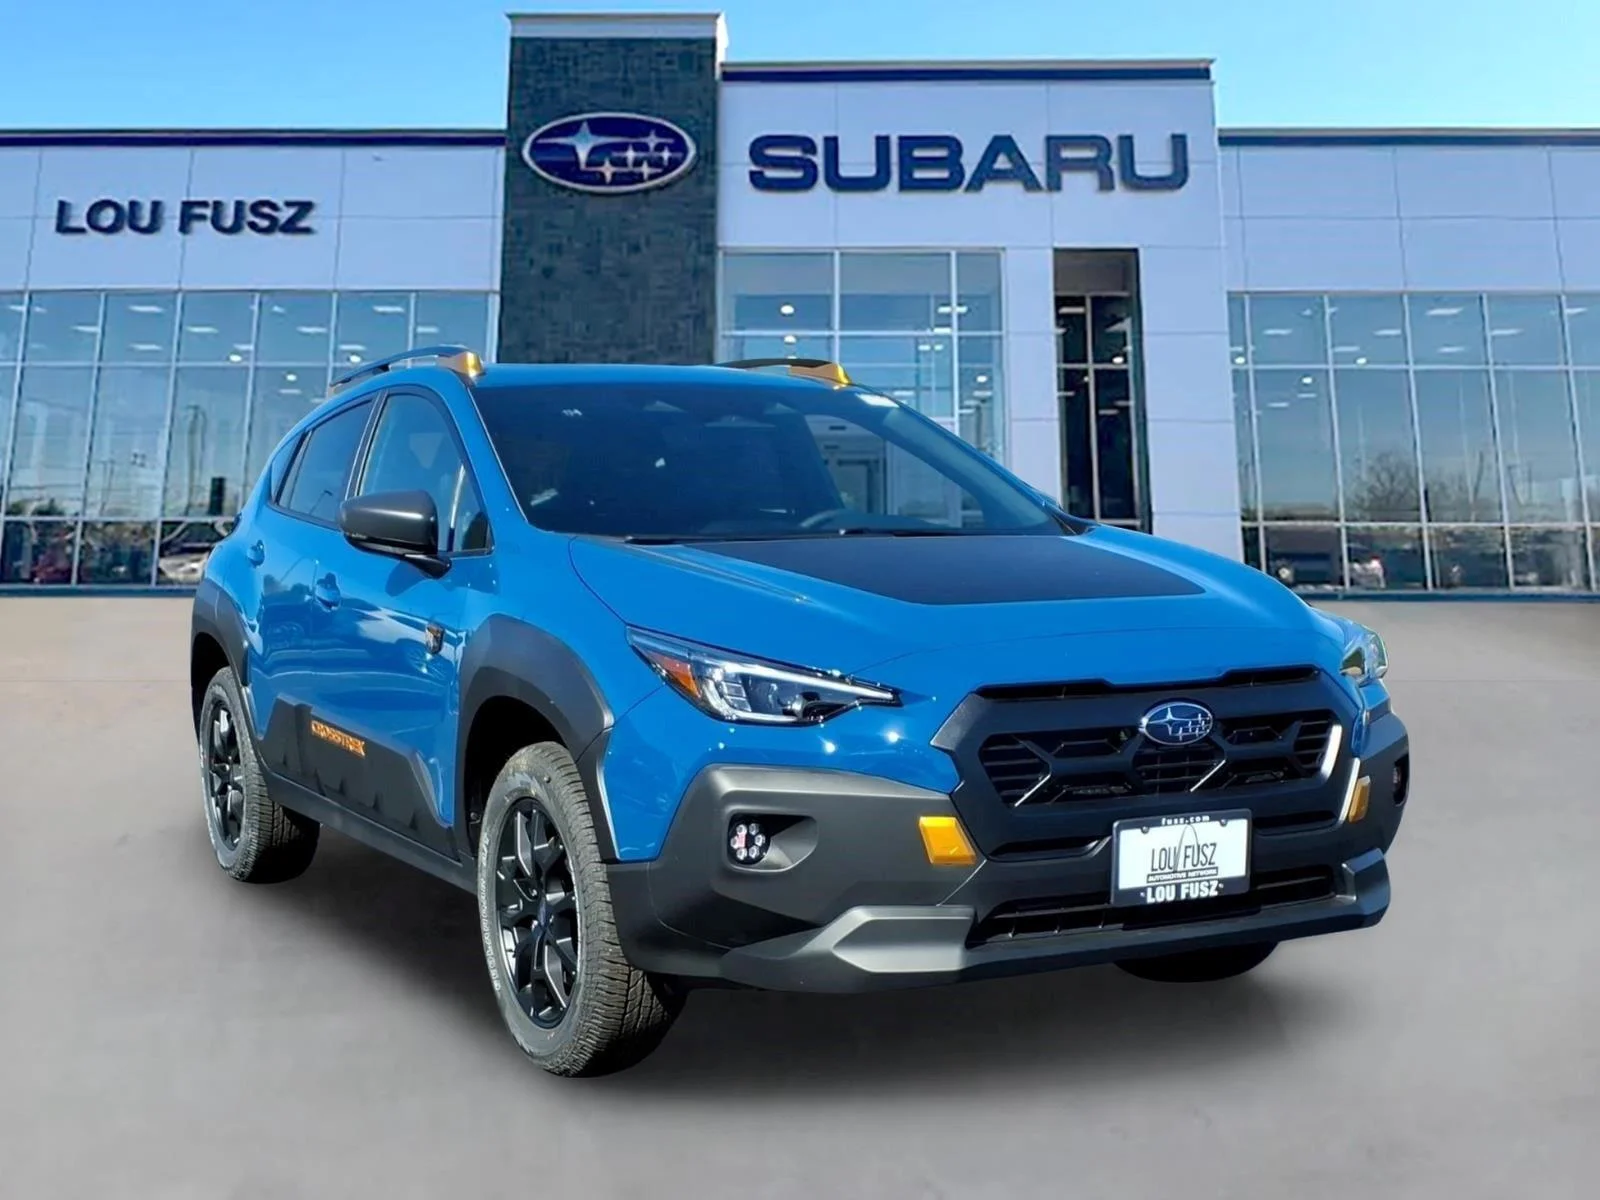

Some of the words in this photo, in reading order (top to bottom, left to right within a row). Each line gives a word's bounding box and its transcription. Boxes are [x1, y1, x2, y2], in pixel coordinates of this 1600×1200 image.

[748, 134, 1189, 191] SUBARU
[55, 199, 163, 234] LOU
[178, 199, 316, 234] FUSZ
[1151, 846, 1177, 872] LOU
[1183, 843, 1217, 868] FUSZ
[1146, 884, 1177, 904] LOU
[1180, 880, 1219, 900] FUSZ
